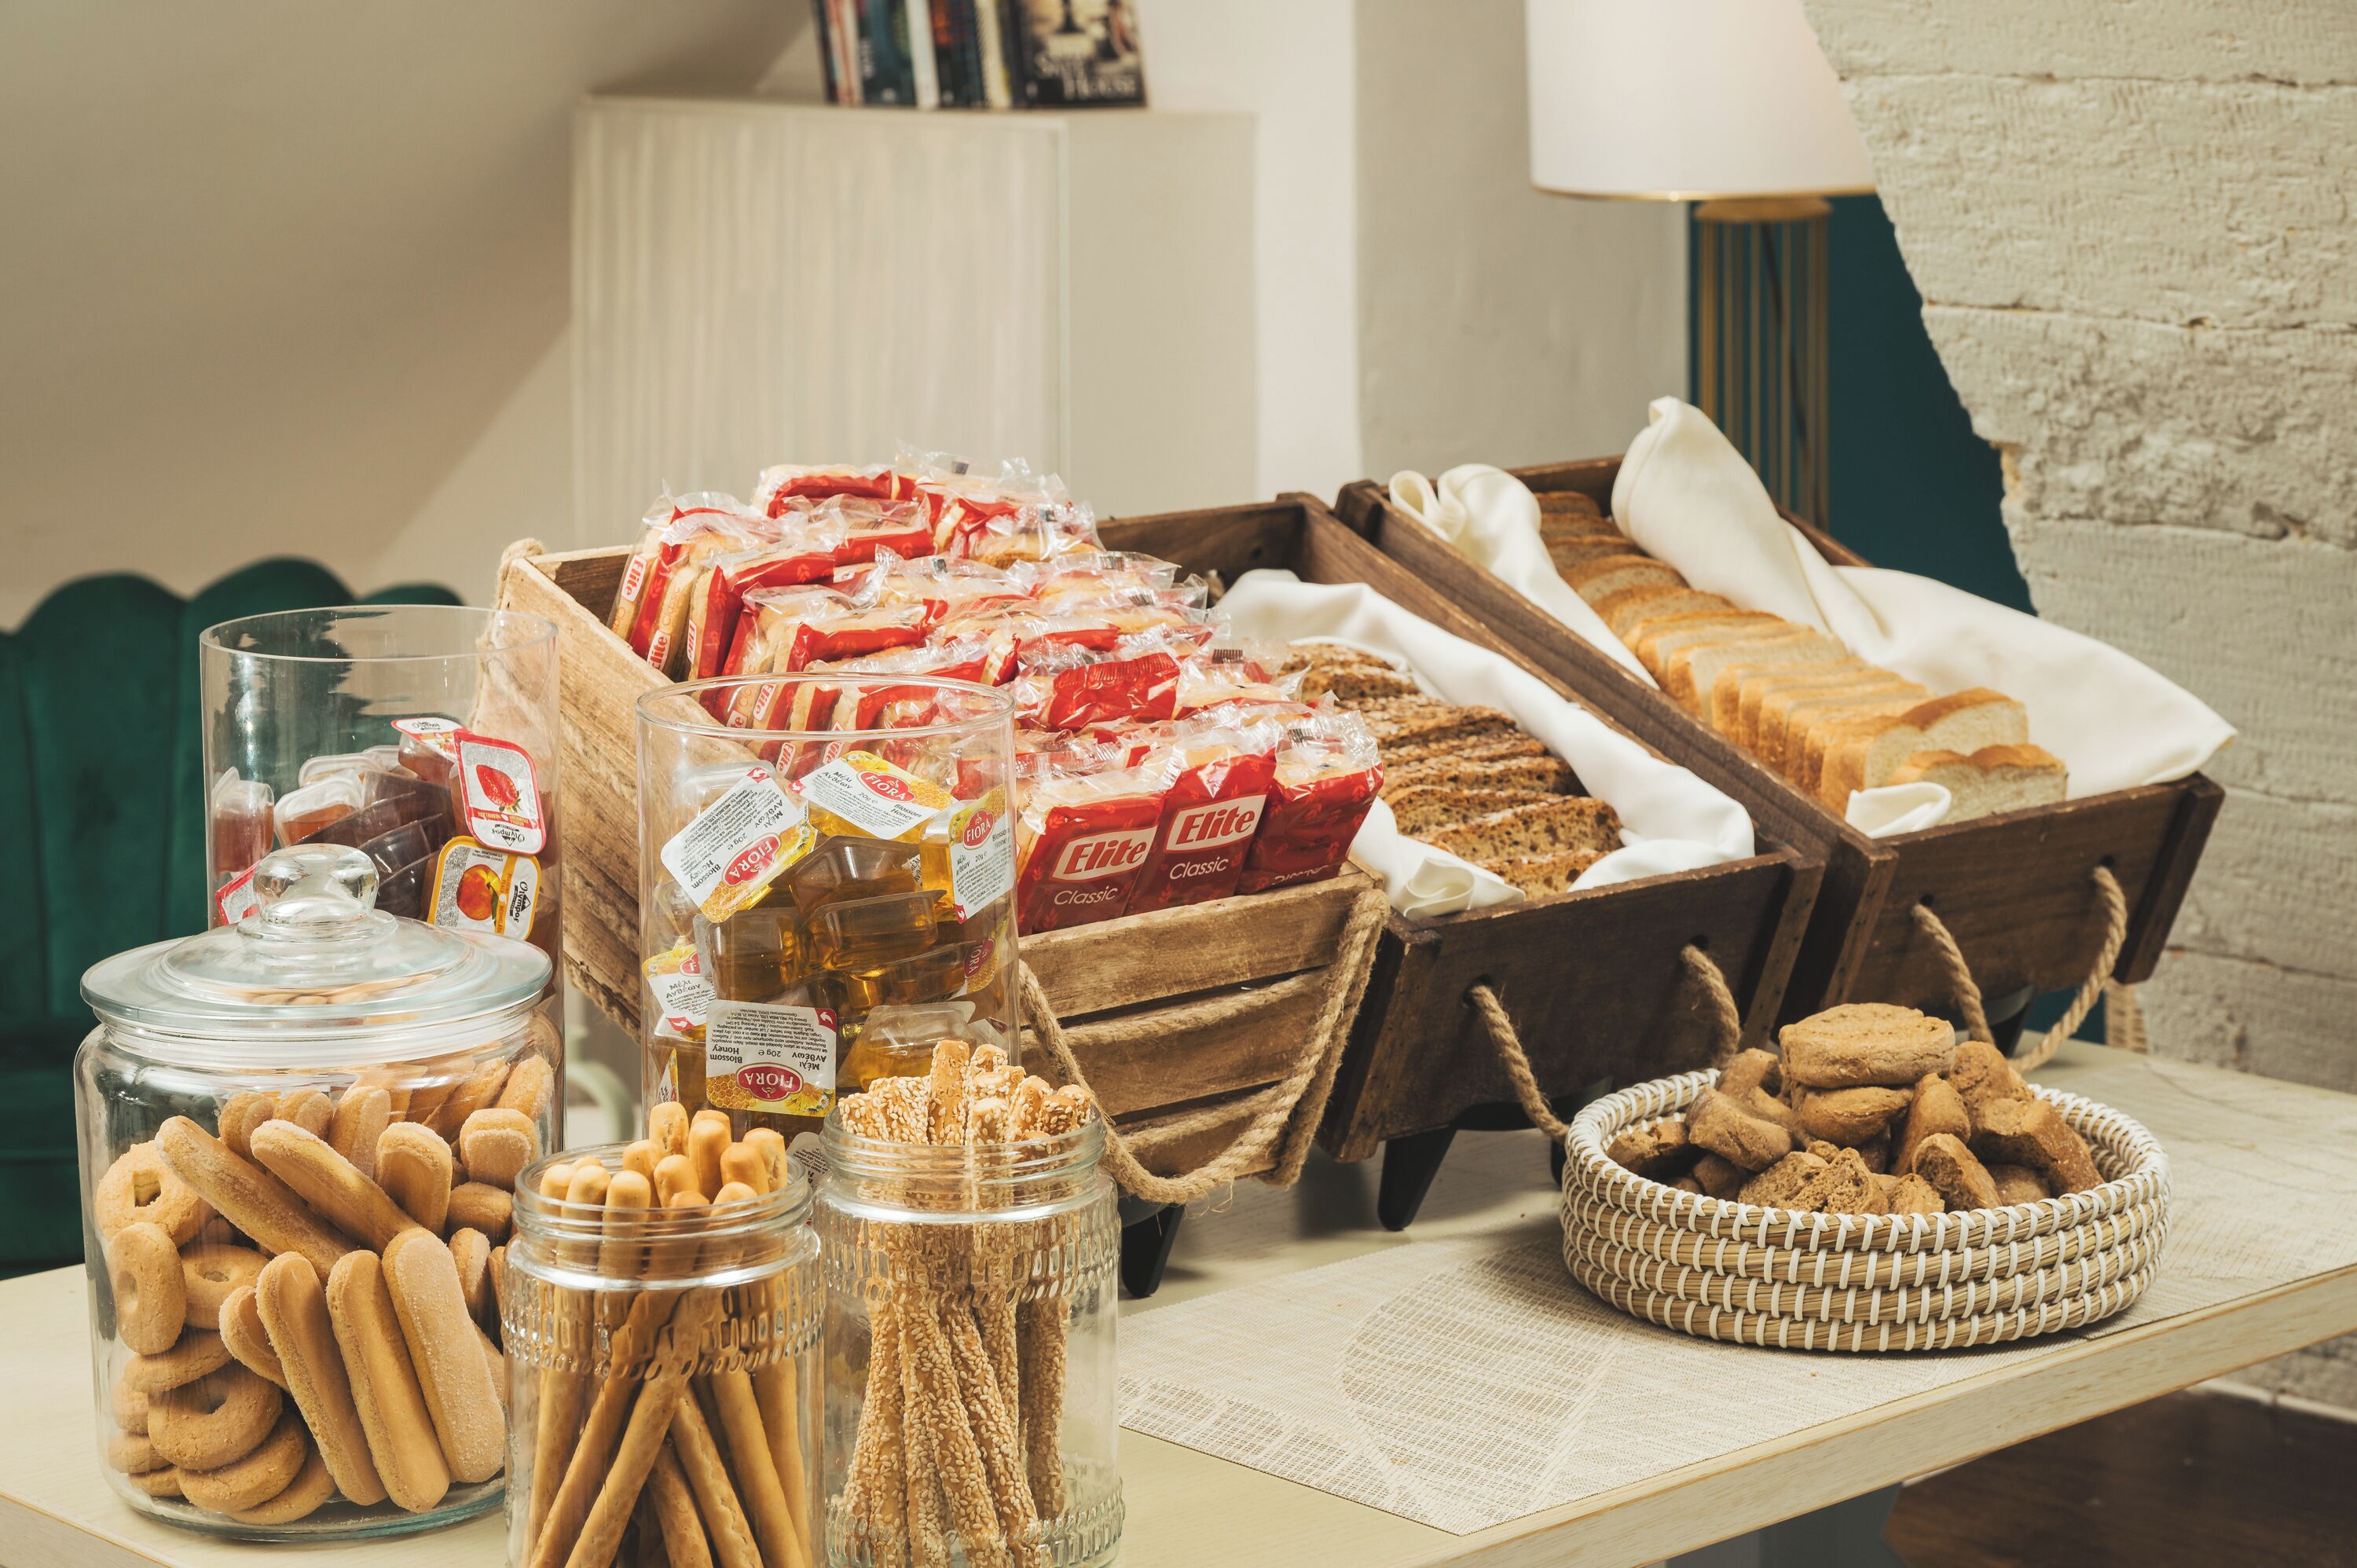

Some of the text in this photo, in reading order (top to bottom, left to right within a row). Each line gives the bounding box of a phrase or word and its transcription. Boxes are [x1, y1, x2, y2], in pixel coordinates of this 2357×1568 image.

[625, 559, 644, 595] Elite
[779, 742, 794, 771] Elite
[864, 775, 906, 800] FIORA
[891, 808, 912, 821] Honey
[894, 804, 922, 818] Blossom
[966, 819, 991, 842] FIORA
[1175, 806, 1255, 844] Elite
[728, 840, 773, 879] FIORA
[1064, 838, 1147, 874] Elite
[691, 864, 720, 889] Blossom
[1169, 856, 1229, 880] Classic
[1054, 885, 1119, 905] Classic
[666, 984, 701, 998] Ανθέων
[669, 980, 691, 990] Μέλι
[709, 1053, 742, 1064] Blossom
[713, 1044, 739, 1054] Honey
[792, 1051, 827, 1063] Ανθέων
[799, 1060, 819, 1071] Μέλι
[745, 1072, 794, 1089] FIORA
